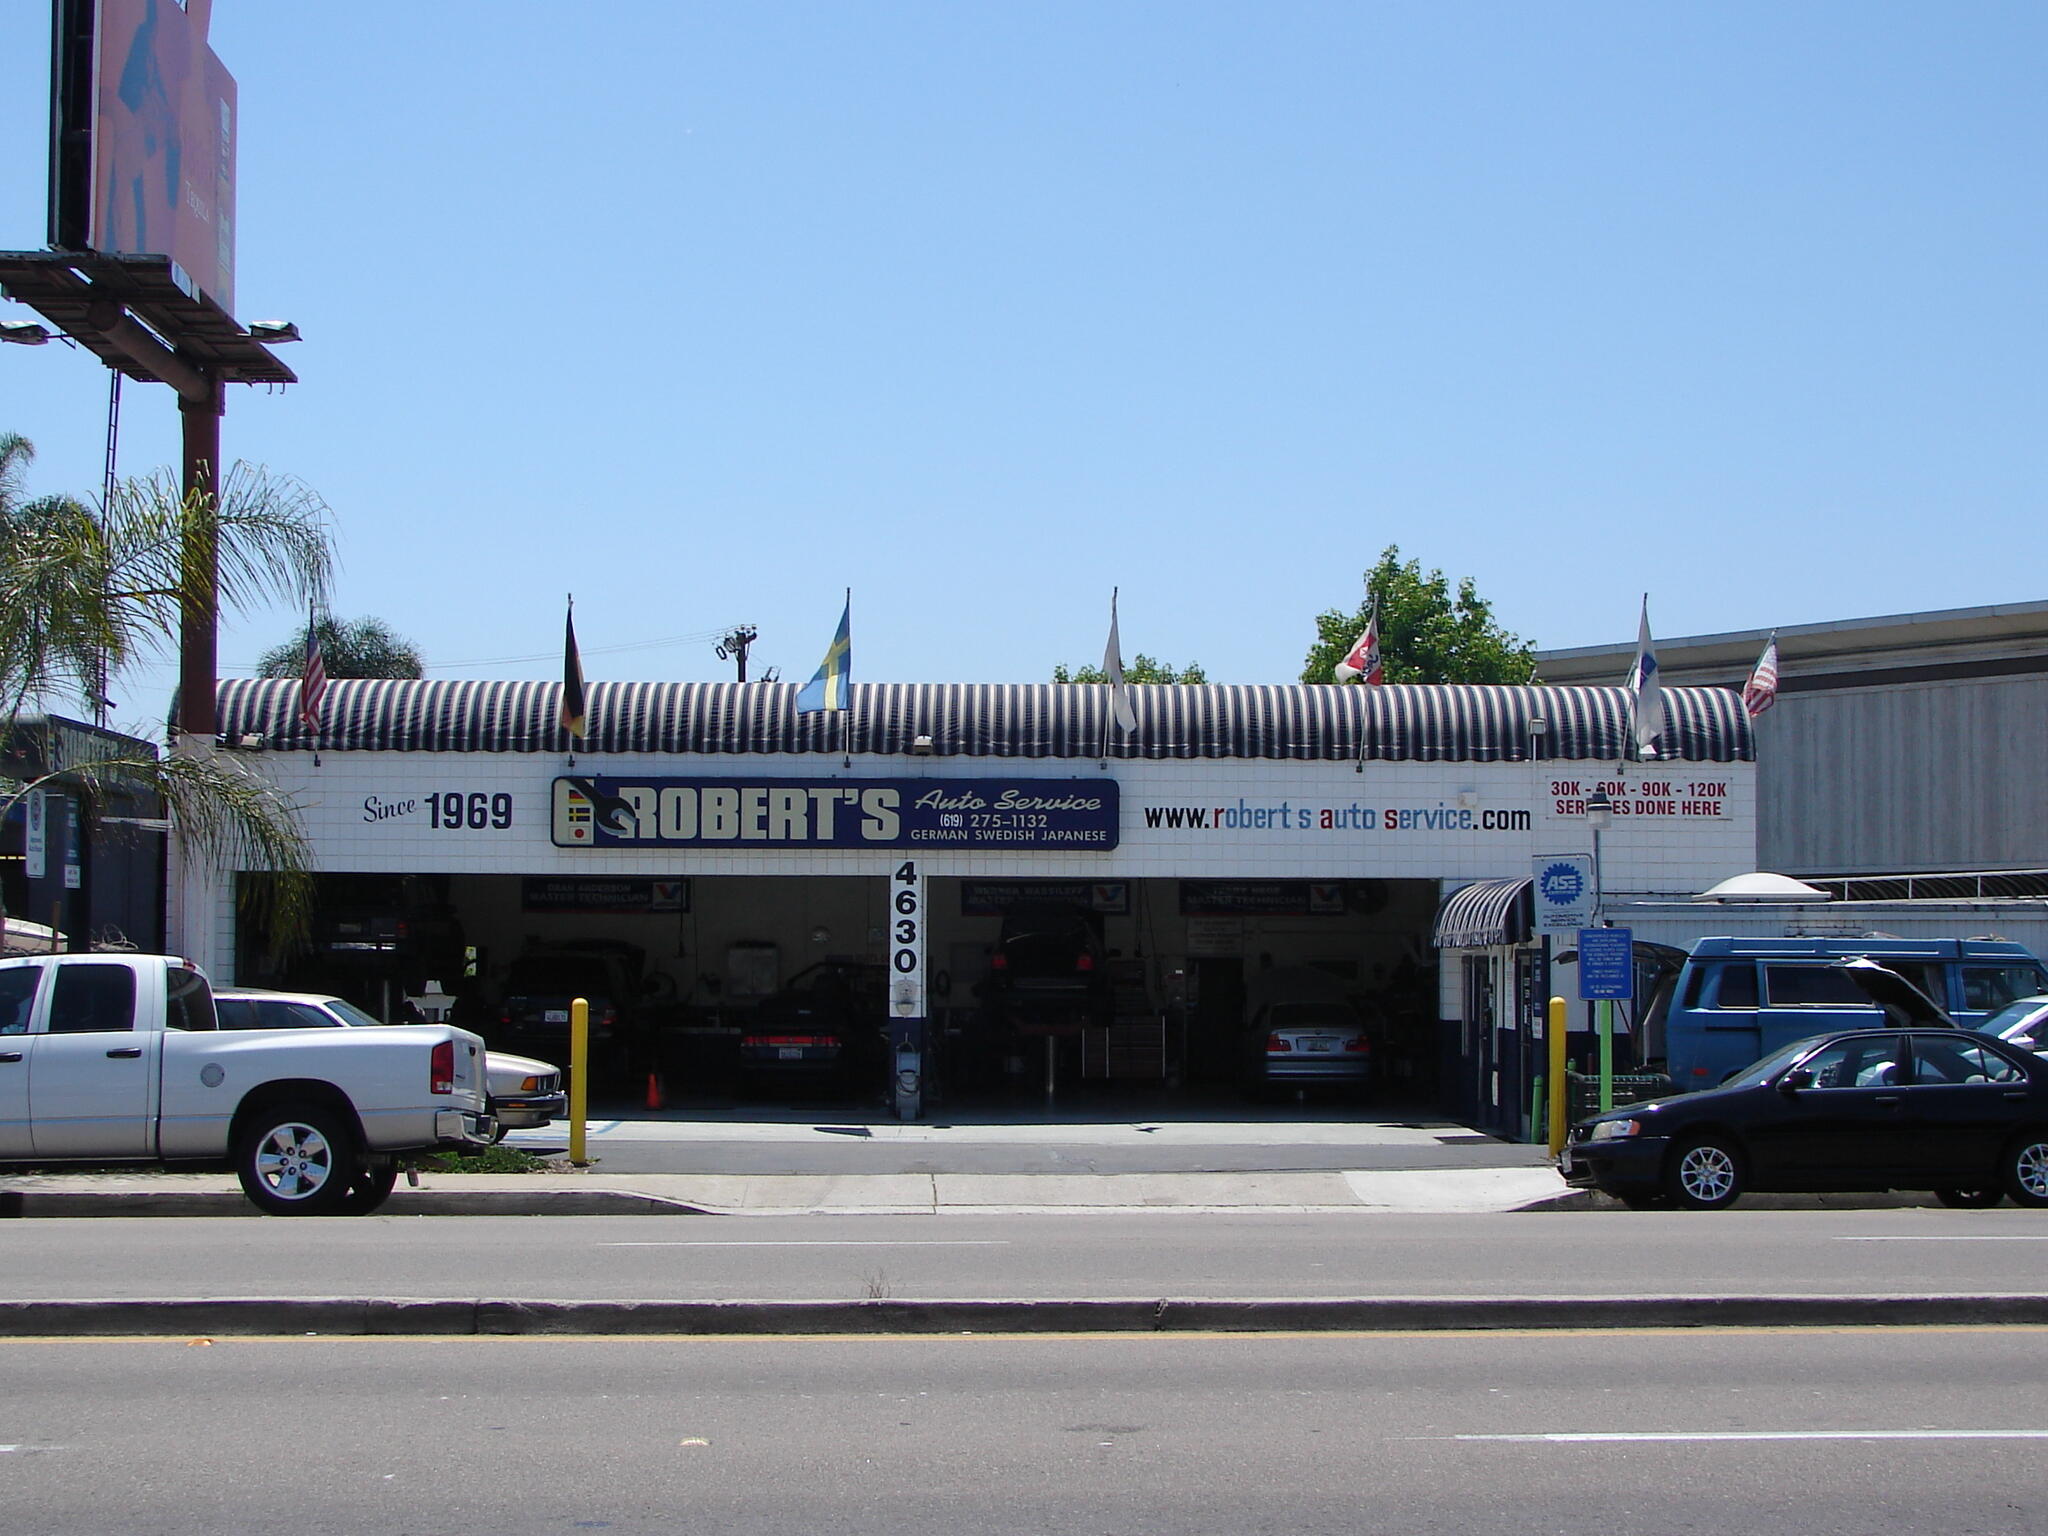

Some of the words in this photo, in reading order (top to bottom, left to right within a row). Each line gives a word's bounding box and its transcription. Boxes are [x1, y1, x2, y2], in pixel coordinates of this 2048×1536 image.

[1551, 781, 1580, 796] 30K
[1642, 782, 1671, 797] 90K
[1688, 782, 1727, 798] 120K
[914, 789, 987, 811] Auto
[994, 789, 1101, 811] Service
[1556, 800, 1631, 815] SERES
[1635, 800, 1676, 815] DONE
[1682, 801, 1722, 816] HERE
[363, 796, 417, 824] Since
[424, 793, 513, 830] 1969
[618, 787, 900, 840] ROBERT'S
[939, 813, 964, 828] (619)
[970, 814, 1048, 829] 275-1132
[911, 829, 968, 841] GERMAN
[975, 830, 1035, 841] SWEDISH
[1041, 830, 1107, 842] JAPANESE
[1546, 875, 1577, 891] ASE
